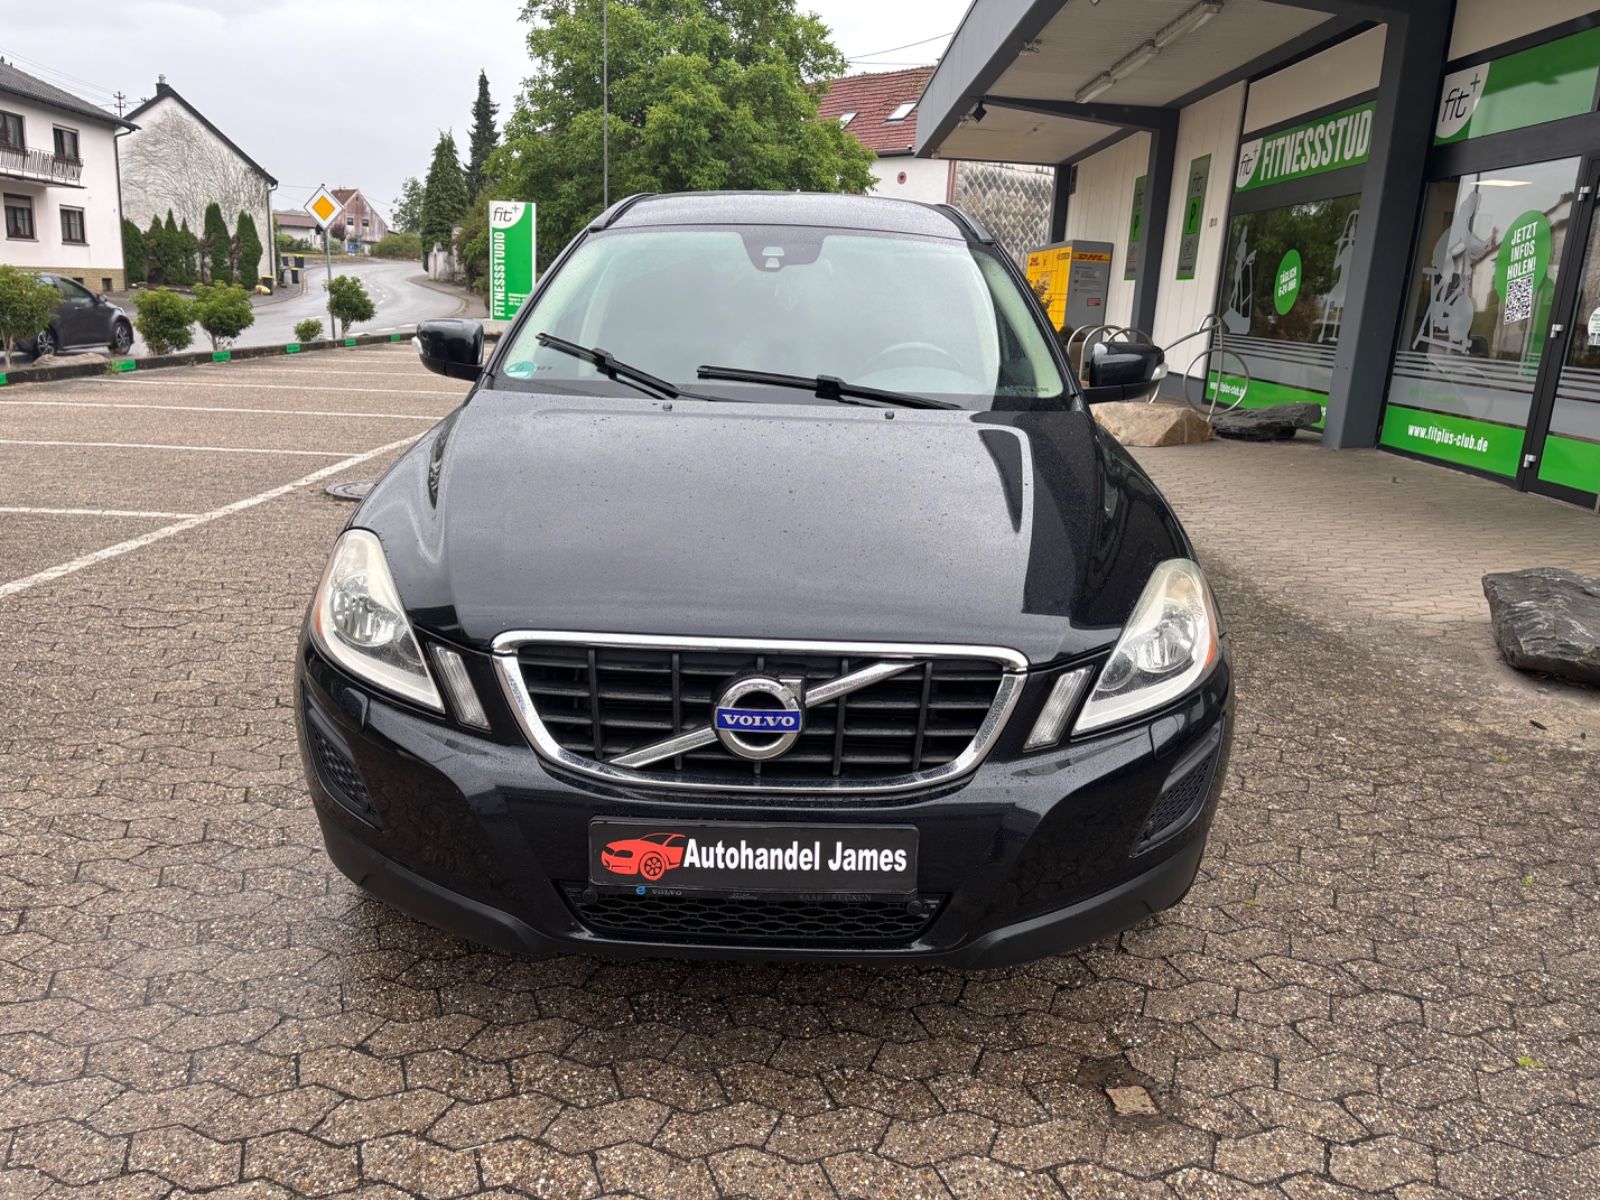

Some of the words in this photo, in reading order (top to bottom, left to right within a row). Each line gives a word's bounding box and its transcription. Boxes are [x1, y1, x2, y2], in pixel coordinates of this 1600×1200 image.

[1260, 109, 1373, 181] FITNESSSTUD
[1511, 221, 1538, 245] JETZT
[1078, 253, 1105, 261] DHL
[1511, 240, 1535, 261] INFOS
[494, 231, 505, 317] FITNESSSTUDIO
[1507, 256, 1536, 280] HOLEN!
[1408, 424, 1488, 453] www.fitplus-club.de
[722, 713, 795, 727] VOLVO
[683, 838, 821, 871] Autohandel
[827, 841, 907, 872] James
[651, 888, 682, 896] VOLVO
